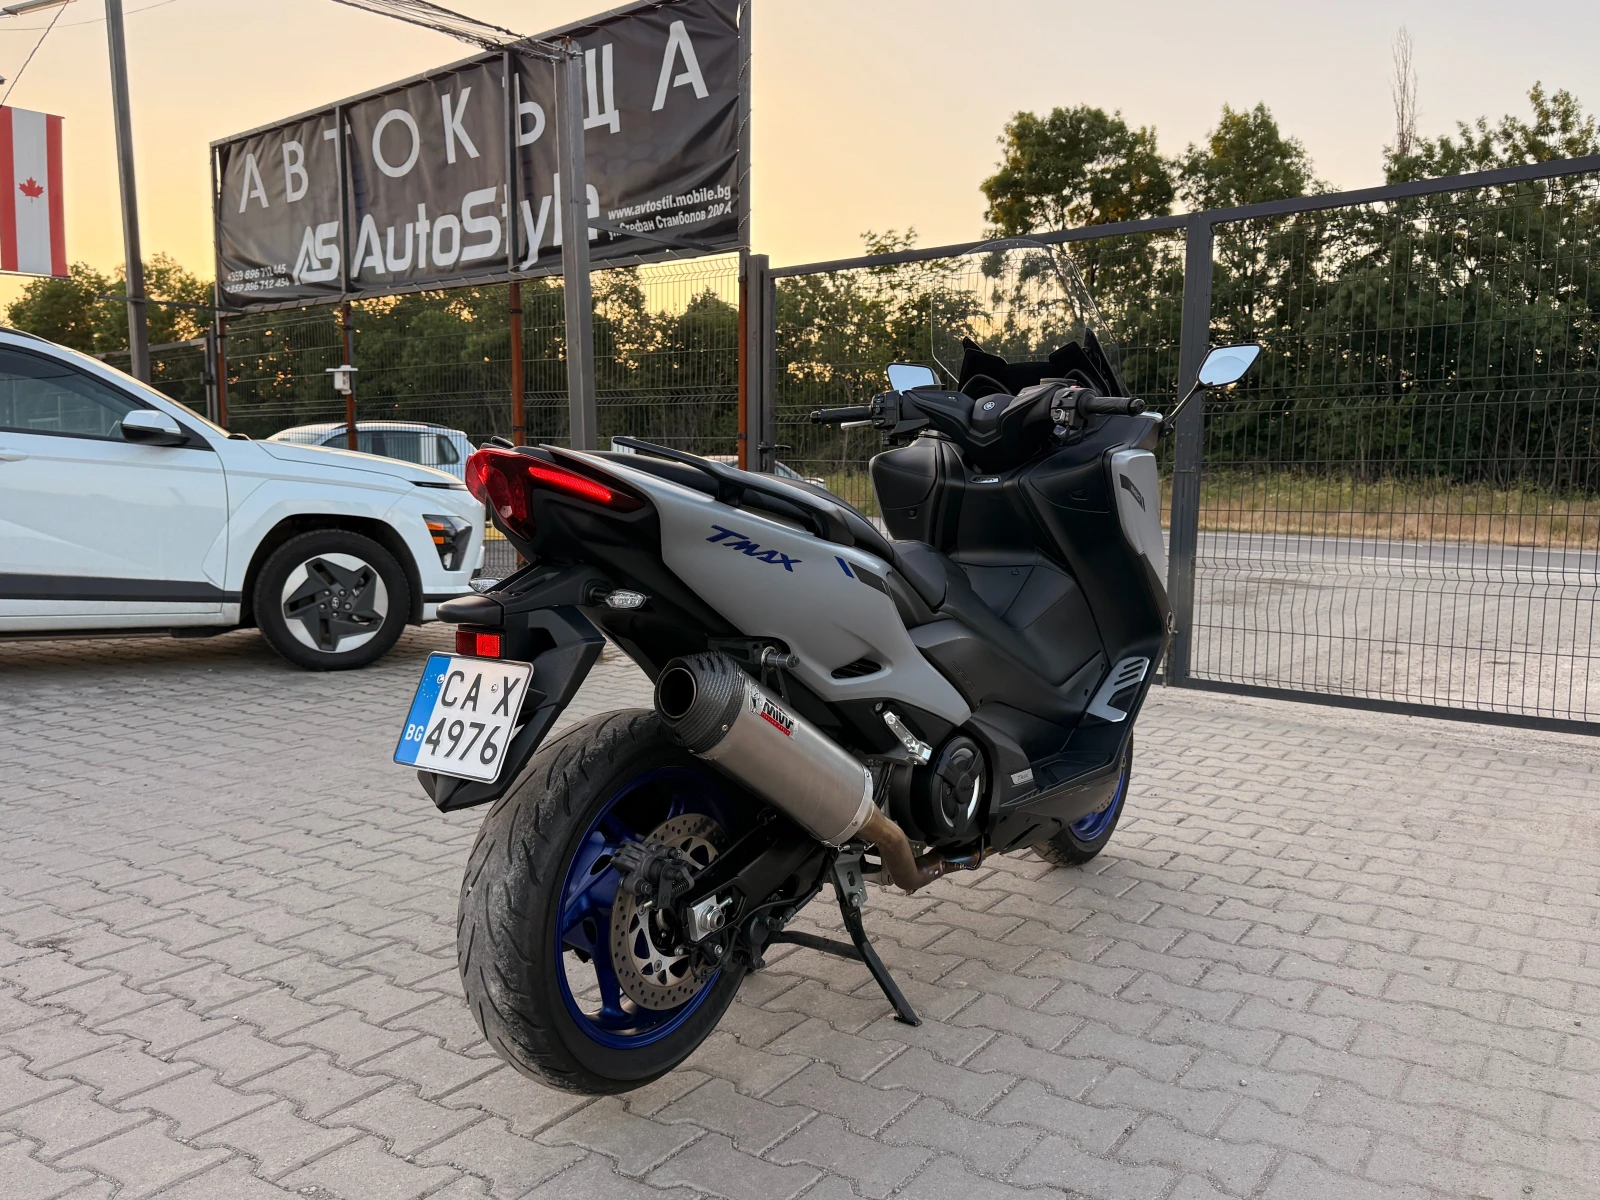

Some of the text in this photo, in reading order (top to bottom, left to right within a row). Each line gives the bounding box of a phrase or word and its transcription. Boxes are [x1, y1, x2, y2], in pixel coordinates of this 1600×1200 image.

[608, 184, 732, 220] www.avtostil.mobile.bg
[655, 211, 706, 229] Стамболов
[260, 279, 275, 290] 712
[706, 524, 802, 572] TMAX
[441, 670, 521, 717] CA X
[405, 723, 425, 742] BG
[425, 717, 501, 765] 4976
